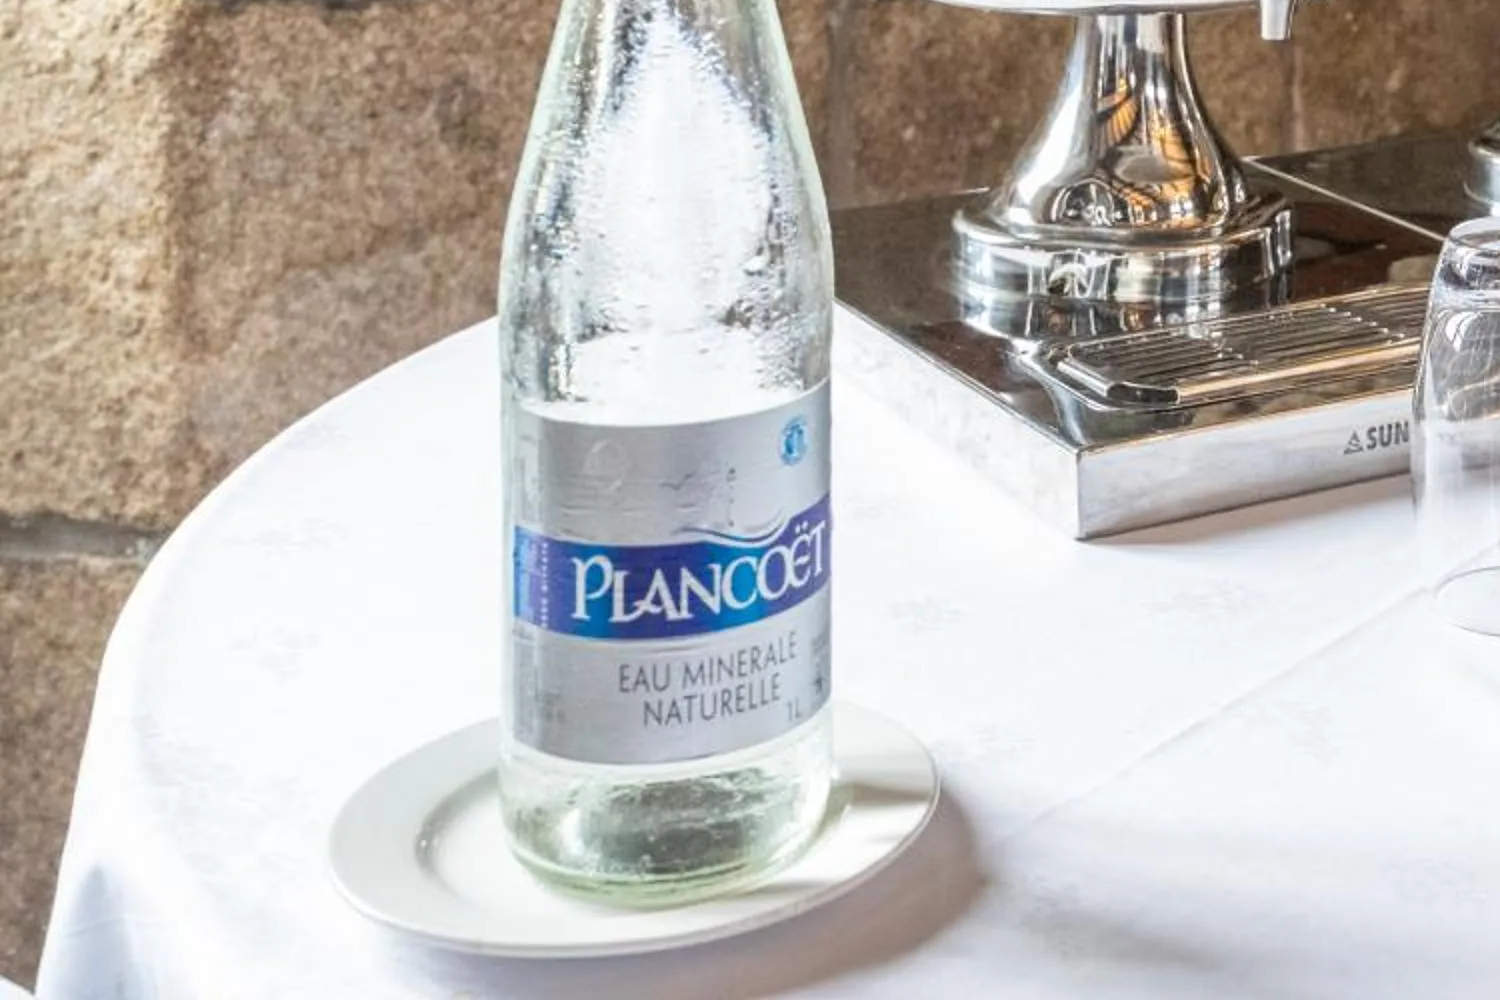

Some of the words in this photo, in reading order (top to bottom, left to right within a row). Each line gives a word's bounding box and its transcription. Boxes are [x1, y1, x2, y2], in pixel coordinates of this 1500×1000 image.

[571, 521, 826, 623] PLANCOËT
[619, 663, 671, 693] EAU
[682, 631, 797, 690] MINERALE
[643, 672, 781, 727] NATURELLE
